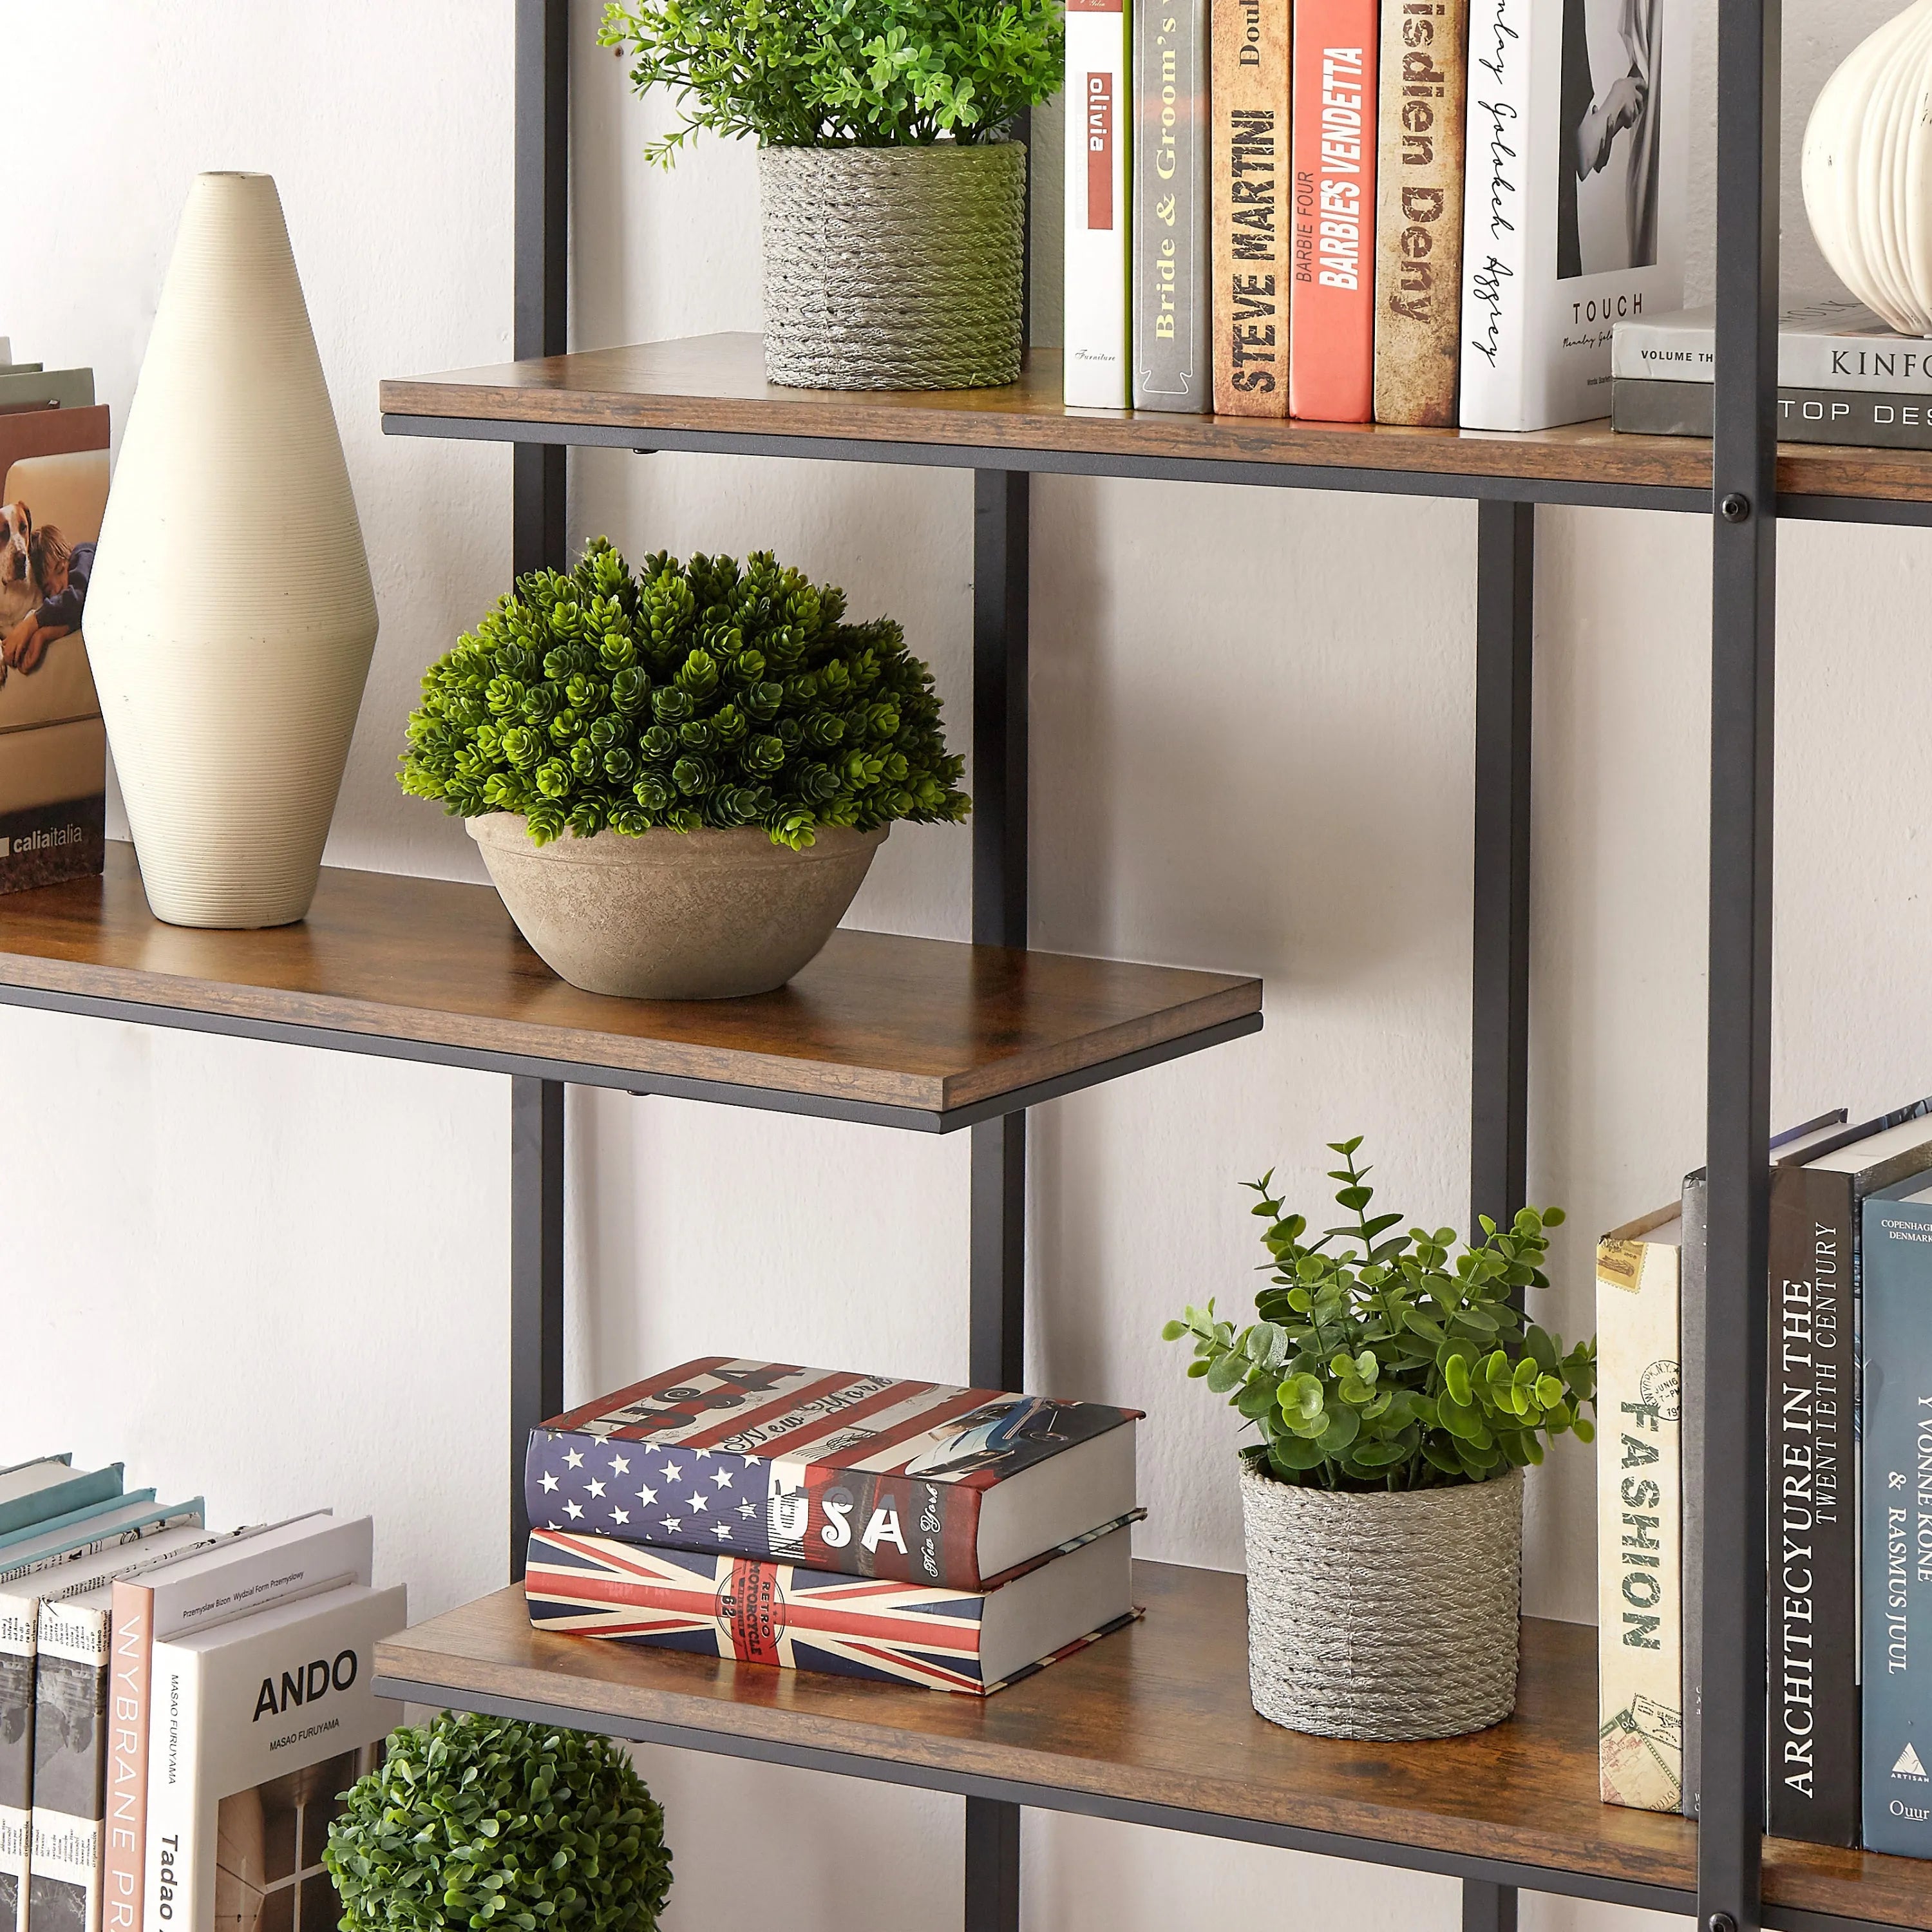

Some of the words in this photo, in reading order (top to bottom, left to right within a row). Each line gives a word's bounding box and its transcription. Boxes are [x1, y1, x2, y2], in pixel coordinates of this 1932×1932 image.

[1090, 77, 1108, 152] olivia
[1157, 17, 1176, 180] Groom's
[1321, 48, 1363, 173] VENDETTA
[1157, 193, 1176, 226] &
[1231, 110, 1275, 260] MARTINI
[1298, 171, 1314, 217] FOUR
[1296, 224, 1312, 282] BARBIE
[1389, 187, 1444, 324] Deny
[1156, 238, 1175, 343] Bride
[1573, 293, 1642, 324] TOUCH
[1075, 349, 1115, 361] Furniture
[1231, 274, 1276, 394] STEVE
[1641, 350, 1692, 361] VOLUME
[1778, 399, 1850, 421] TOP
[1873, 405, 1932, 426] DE
[14, 824, 82, 853] caliaitalia
[1881, 1219, 1932, 1232] COPENHAG
[1889, 1231, 1932, 1243] DENMARK
[1815, 1222, 1837, 1349] CENTURY
[1783, 1280, 1813, 1372] THE
[1783, 1382, 1813, 1435] IN
[1815, 1363, 1837, 1524] TWENTIETH
[1888, 1471, 1907, 1491] &
[774, 1479, 909, 1555] USA
[1621, 1401, 1661, 1651] FASHION
[1888, 1506, 1907, 1608] RASMUS
[747, 1560, 762, 1655] MOTORCYCLE
[760, 1581, 771, 1638] RETRO
[1783, 1444, 1813, 1798] ARCHITECYURE
[1886, 1612, 1907, 1674] JUUL
[169, 1674, 179, 1717] MASAO
[252, 1649, 357, 1723] ANDO
[111, 1615, 140, 1853] WYBRANE
[168, 1719, 178, 1785] FURUYAMA
[269, 1734, 297, 1751] MASAO
[298, 1718, 340, 1741] FURUYAMA
[1891, 1772, 1929, 1783] ARTISAN
[1889, 1800, 1930, 1821] Ouur
[109, 1870, 134, 1932] PR
[160, 1835, 178, 1920] Tadao
